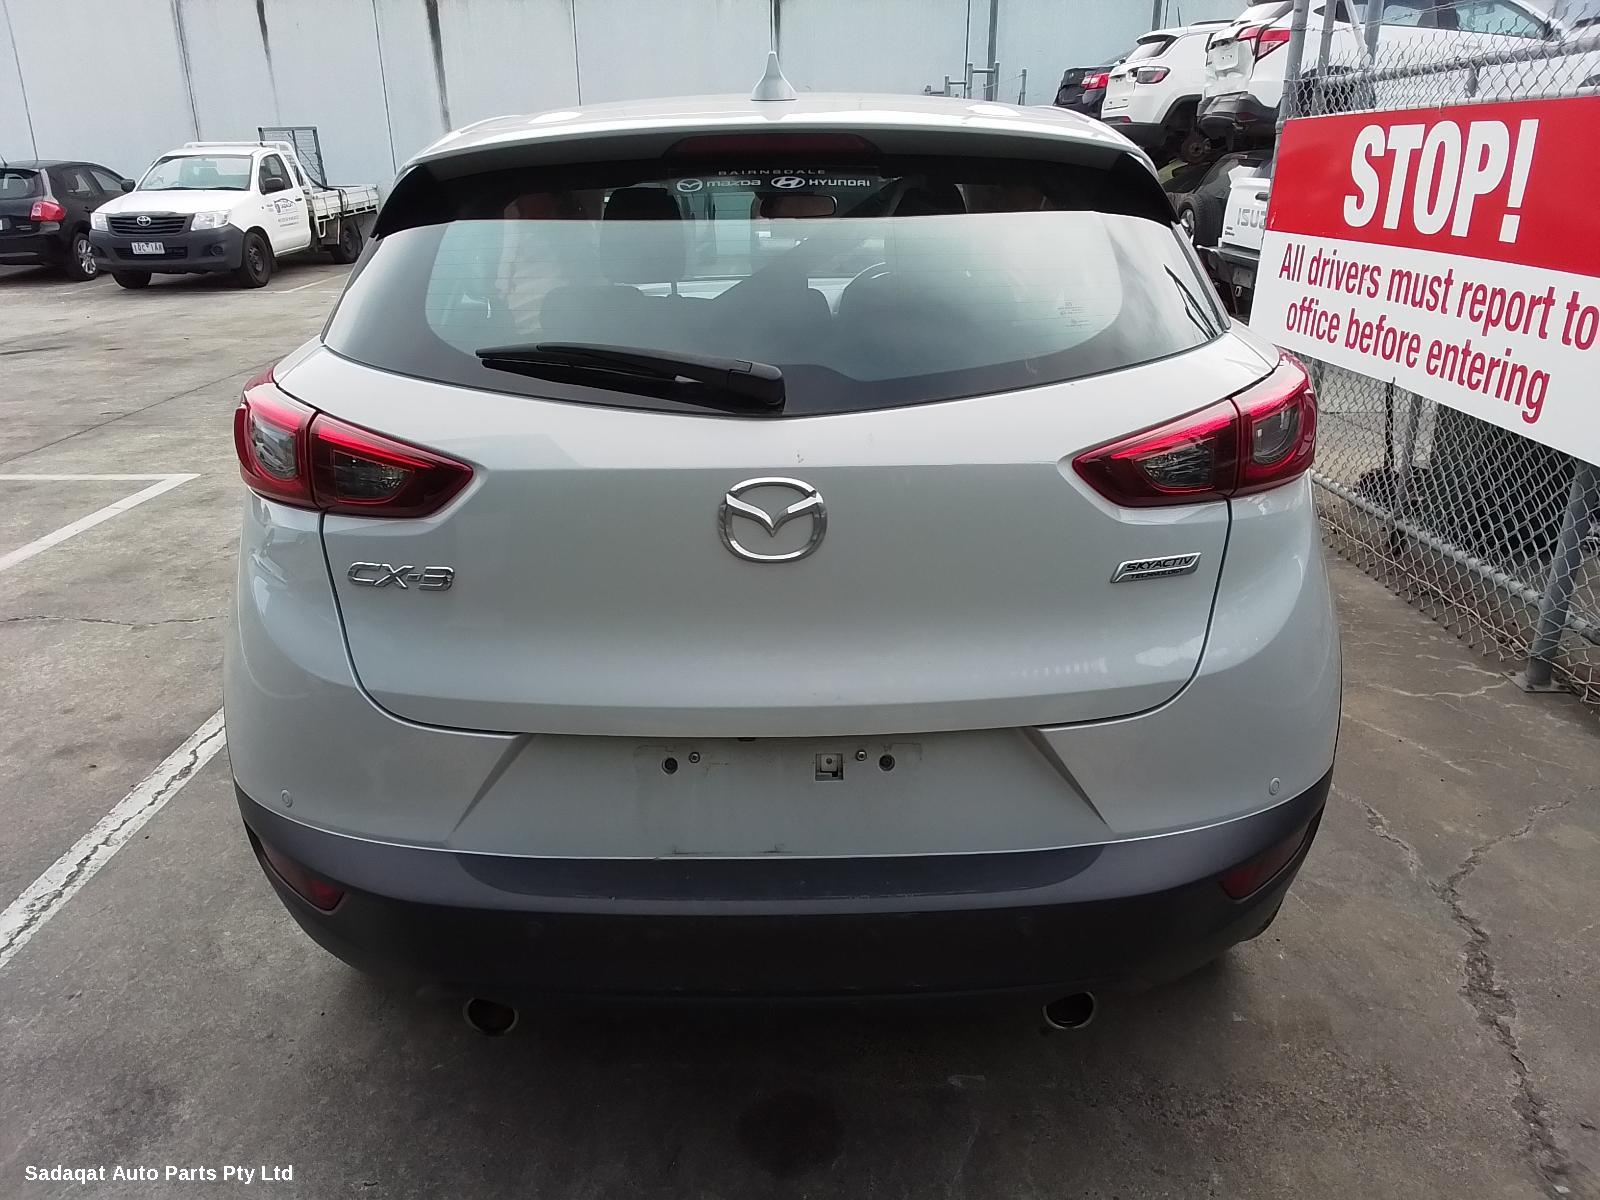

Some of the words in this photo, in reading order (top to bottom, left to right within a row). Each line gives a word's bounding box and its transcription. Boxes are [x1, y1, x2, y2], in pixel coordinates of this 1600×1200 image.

[1343, 118, 1540, 244] STOP!
[1279, 243, 1306, 282] All
[1307, 247, 1382, 298] drivers
[1386, 268, 1454, 315] must
[1456, 286, 1556, 339] report
[1561, 291, 1600, 350] to
[1286, 296, 1341, 344] office
[1344, 308, 1422, 369] before
[1426, 339, 1551, 425] entering
[347, 561, 455, 592] CX-3
[1125, 557, 1195, 571] SKYACTIV
